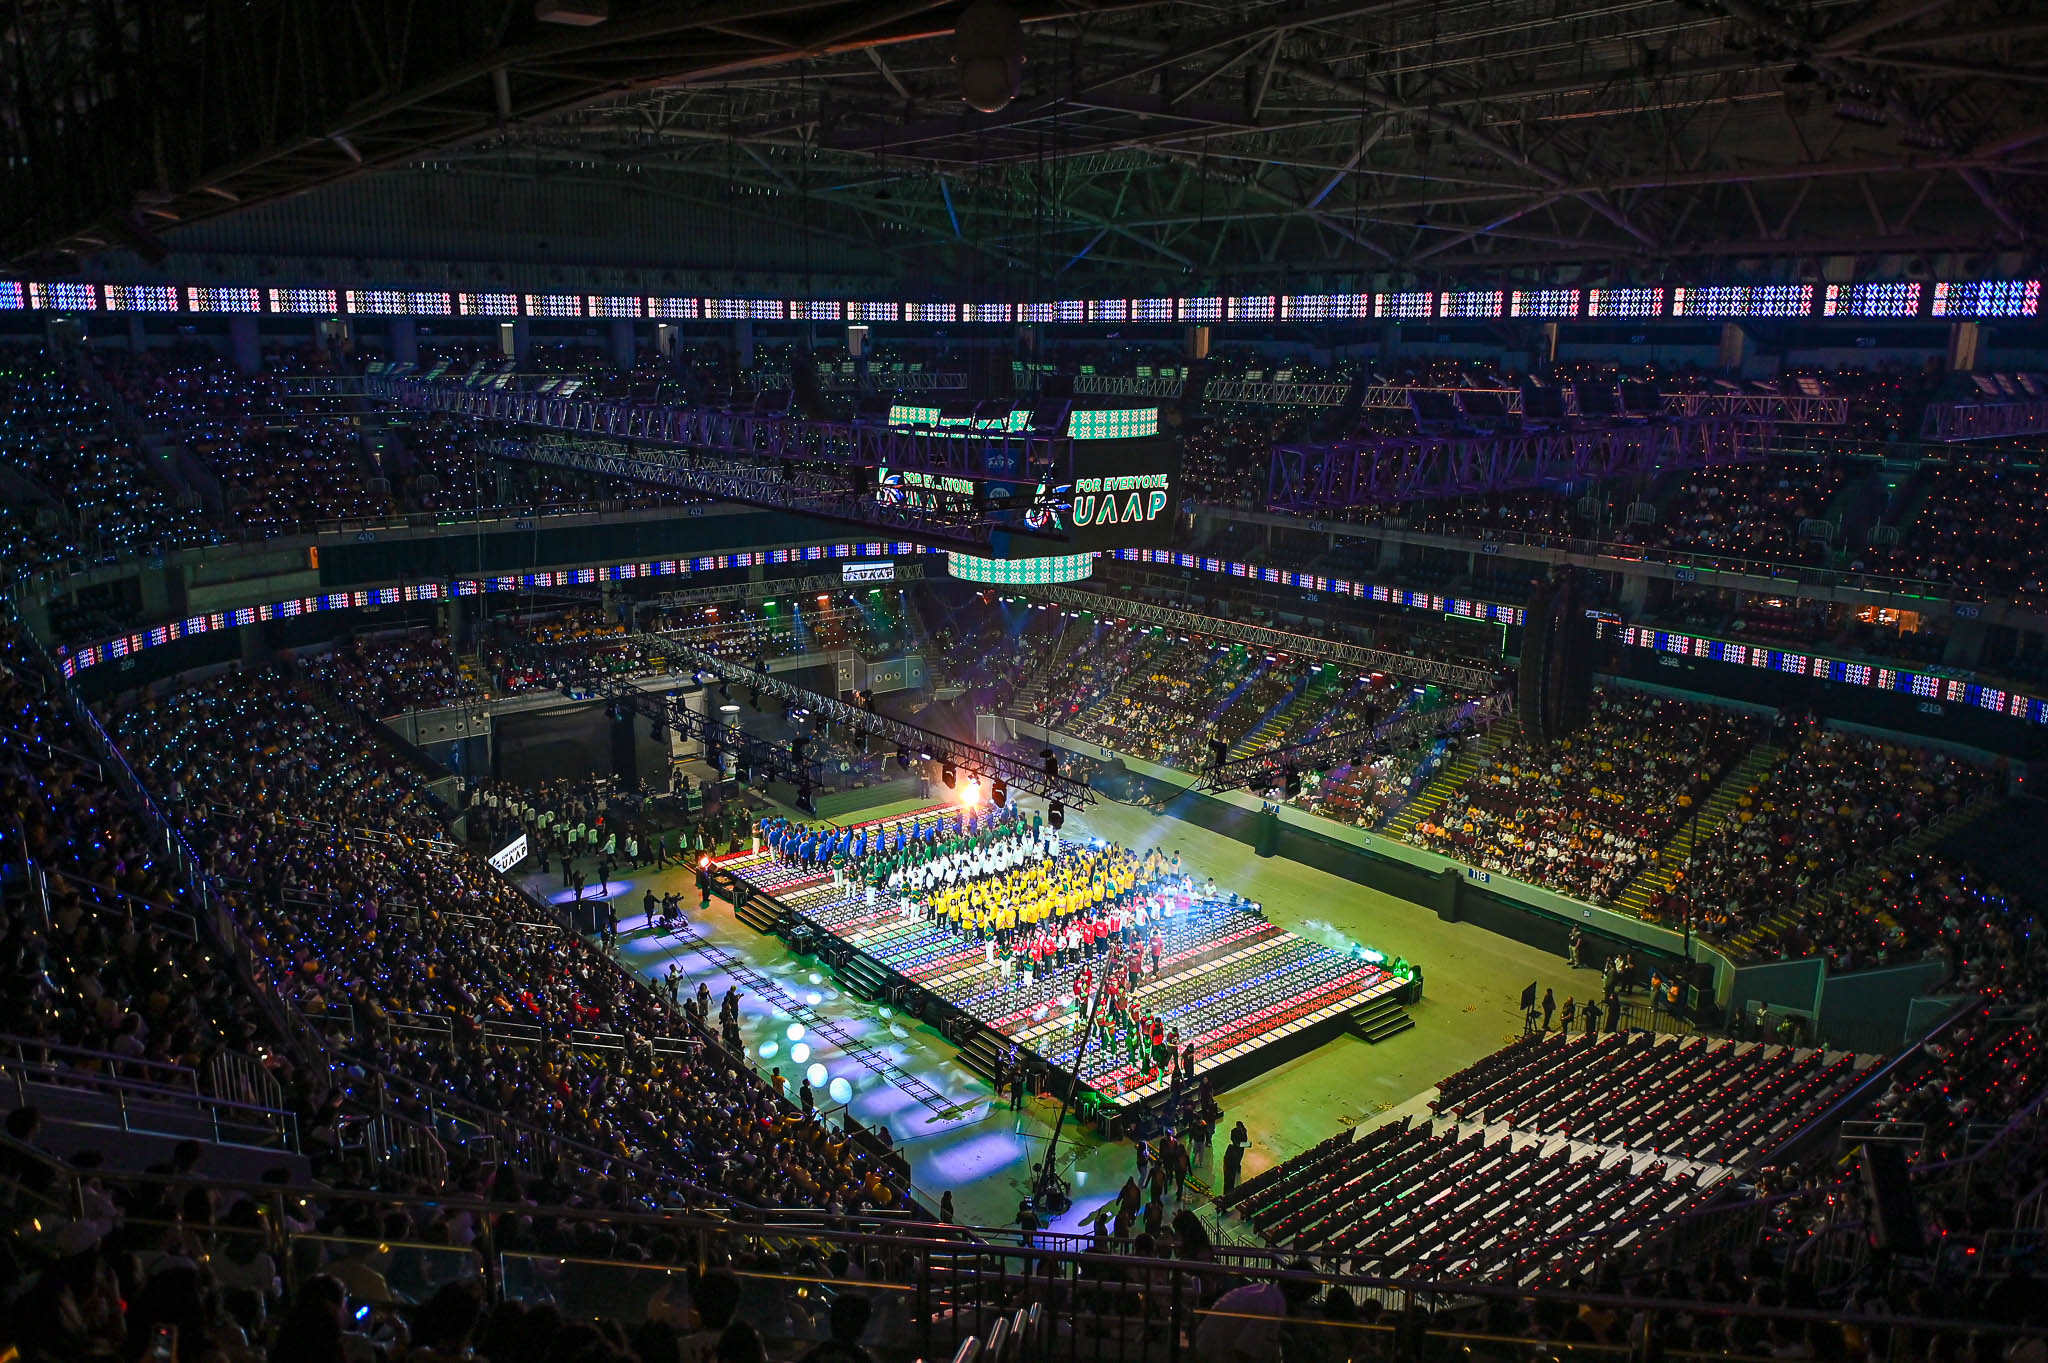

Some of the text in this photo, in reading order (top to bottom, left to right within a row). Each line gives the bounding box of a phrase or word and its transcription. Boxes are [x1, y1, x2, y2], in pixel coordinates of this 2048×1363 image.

[903, 472, 923, 487] FOR
[1075, 473, 1169, 493] FOR EVERYONE,
[1073, 490, 1168, 527] UAAP
[358, 532, 374, 541] 410
[1484, 544, 1498, 554] 417
[1678, 570, 1695, 581] 418
[1307, 593, 1318, 602] 216
[1956, 607, 1978, 617] 419
[1920, 702, 1942, 714] 219
[1102, 747, 1112, 758] 116
[502, 846, 526, 869] UAAP
[1472, 869, 1487, 882] 118
